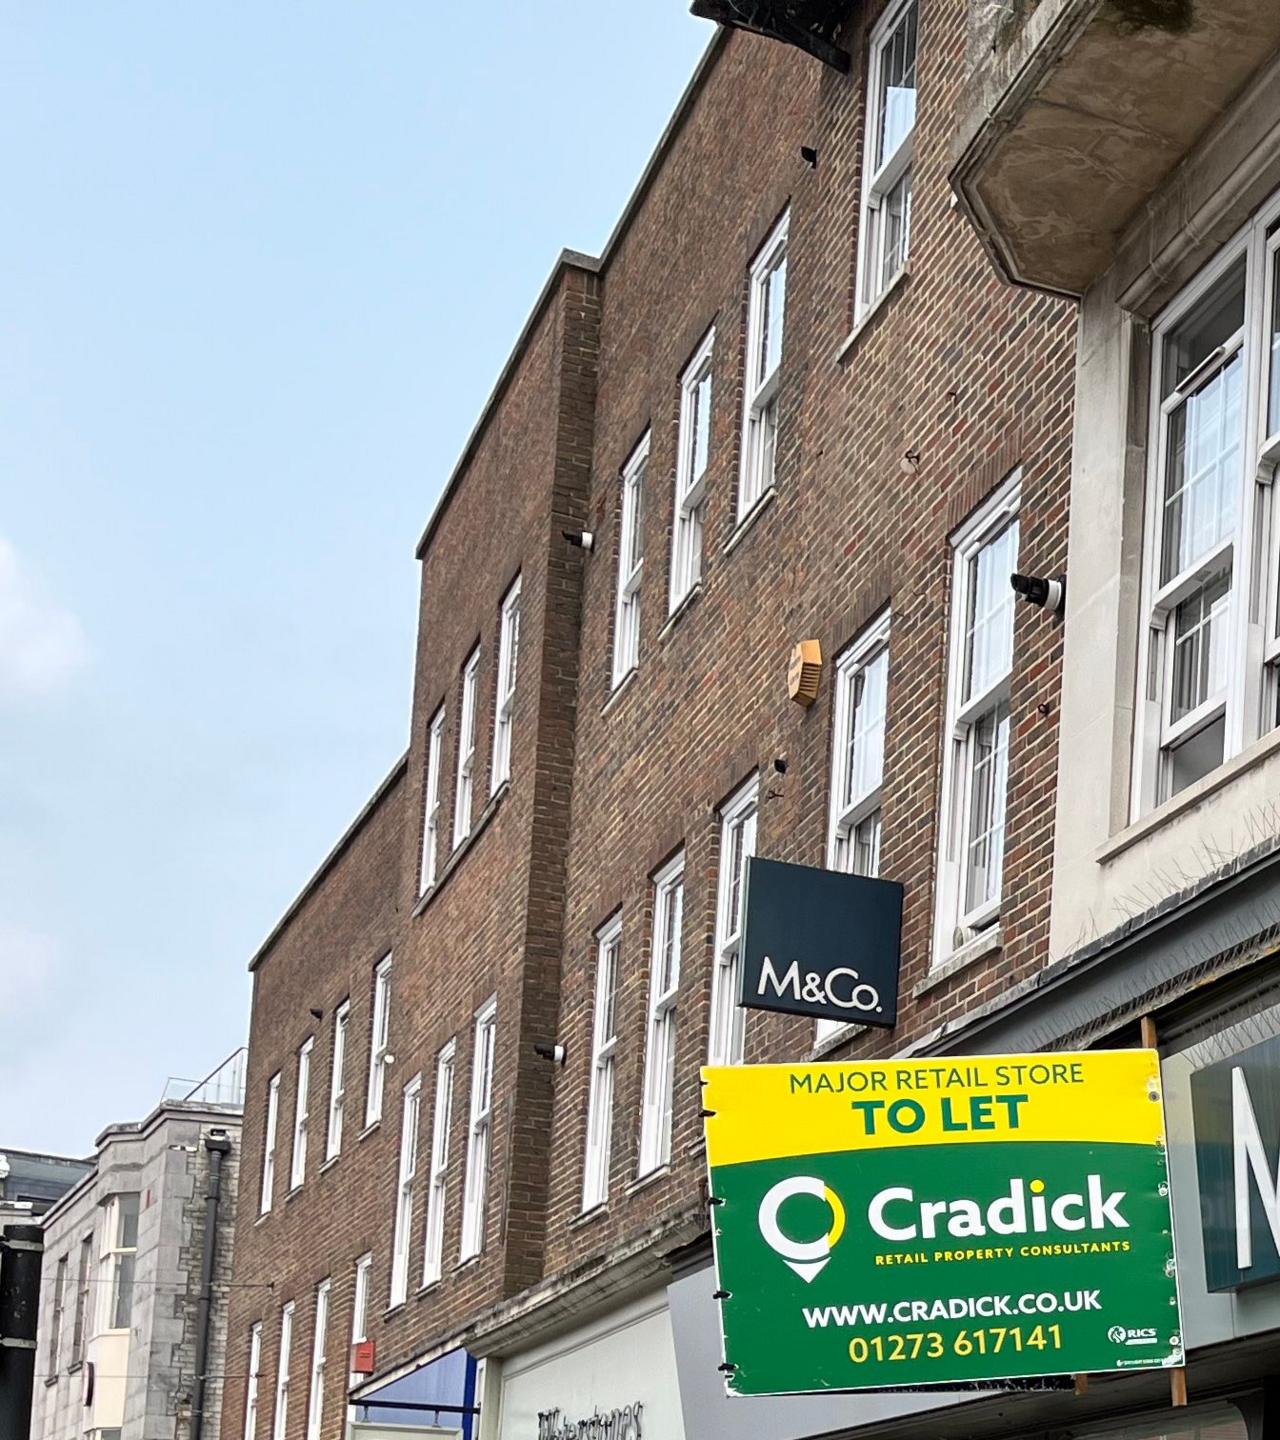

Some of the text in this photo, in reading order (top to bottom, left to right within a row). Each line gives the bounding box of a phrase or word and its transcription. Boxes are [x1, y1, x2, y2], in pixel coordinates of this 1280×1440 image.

[758, 956, 882, 1013] M&Co.
[790, 1063, 1084, 1094] MAJOR RETAIL STORE
[852, 1094, 1029, 1135] TO LET
[867, 1174, 1130, 1241] Cradick
[875, 1241, 1131, 1266] RETAIL PROPERTY CONSULTANTS
[802, 1290, 1102, 1329] WWW.CRADICK.CO.UK
[849, 1324, 1062, 1363] 01273 617141
[1127, 1328, 1157, 1338] RICS
